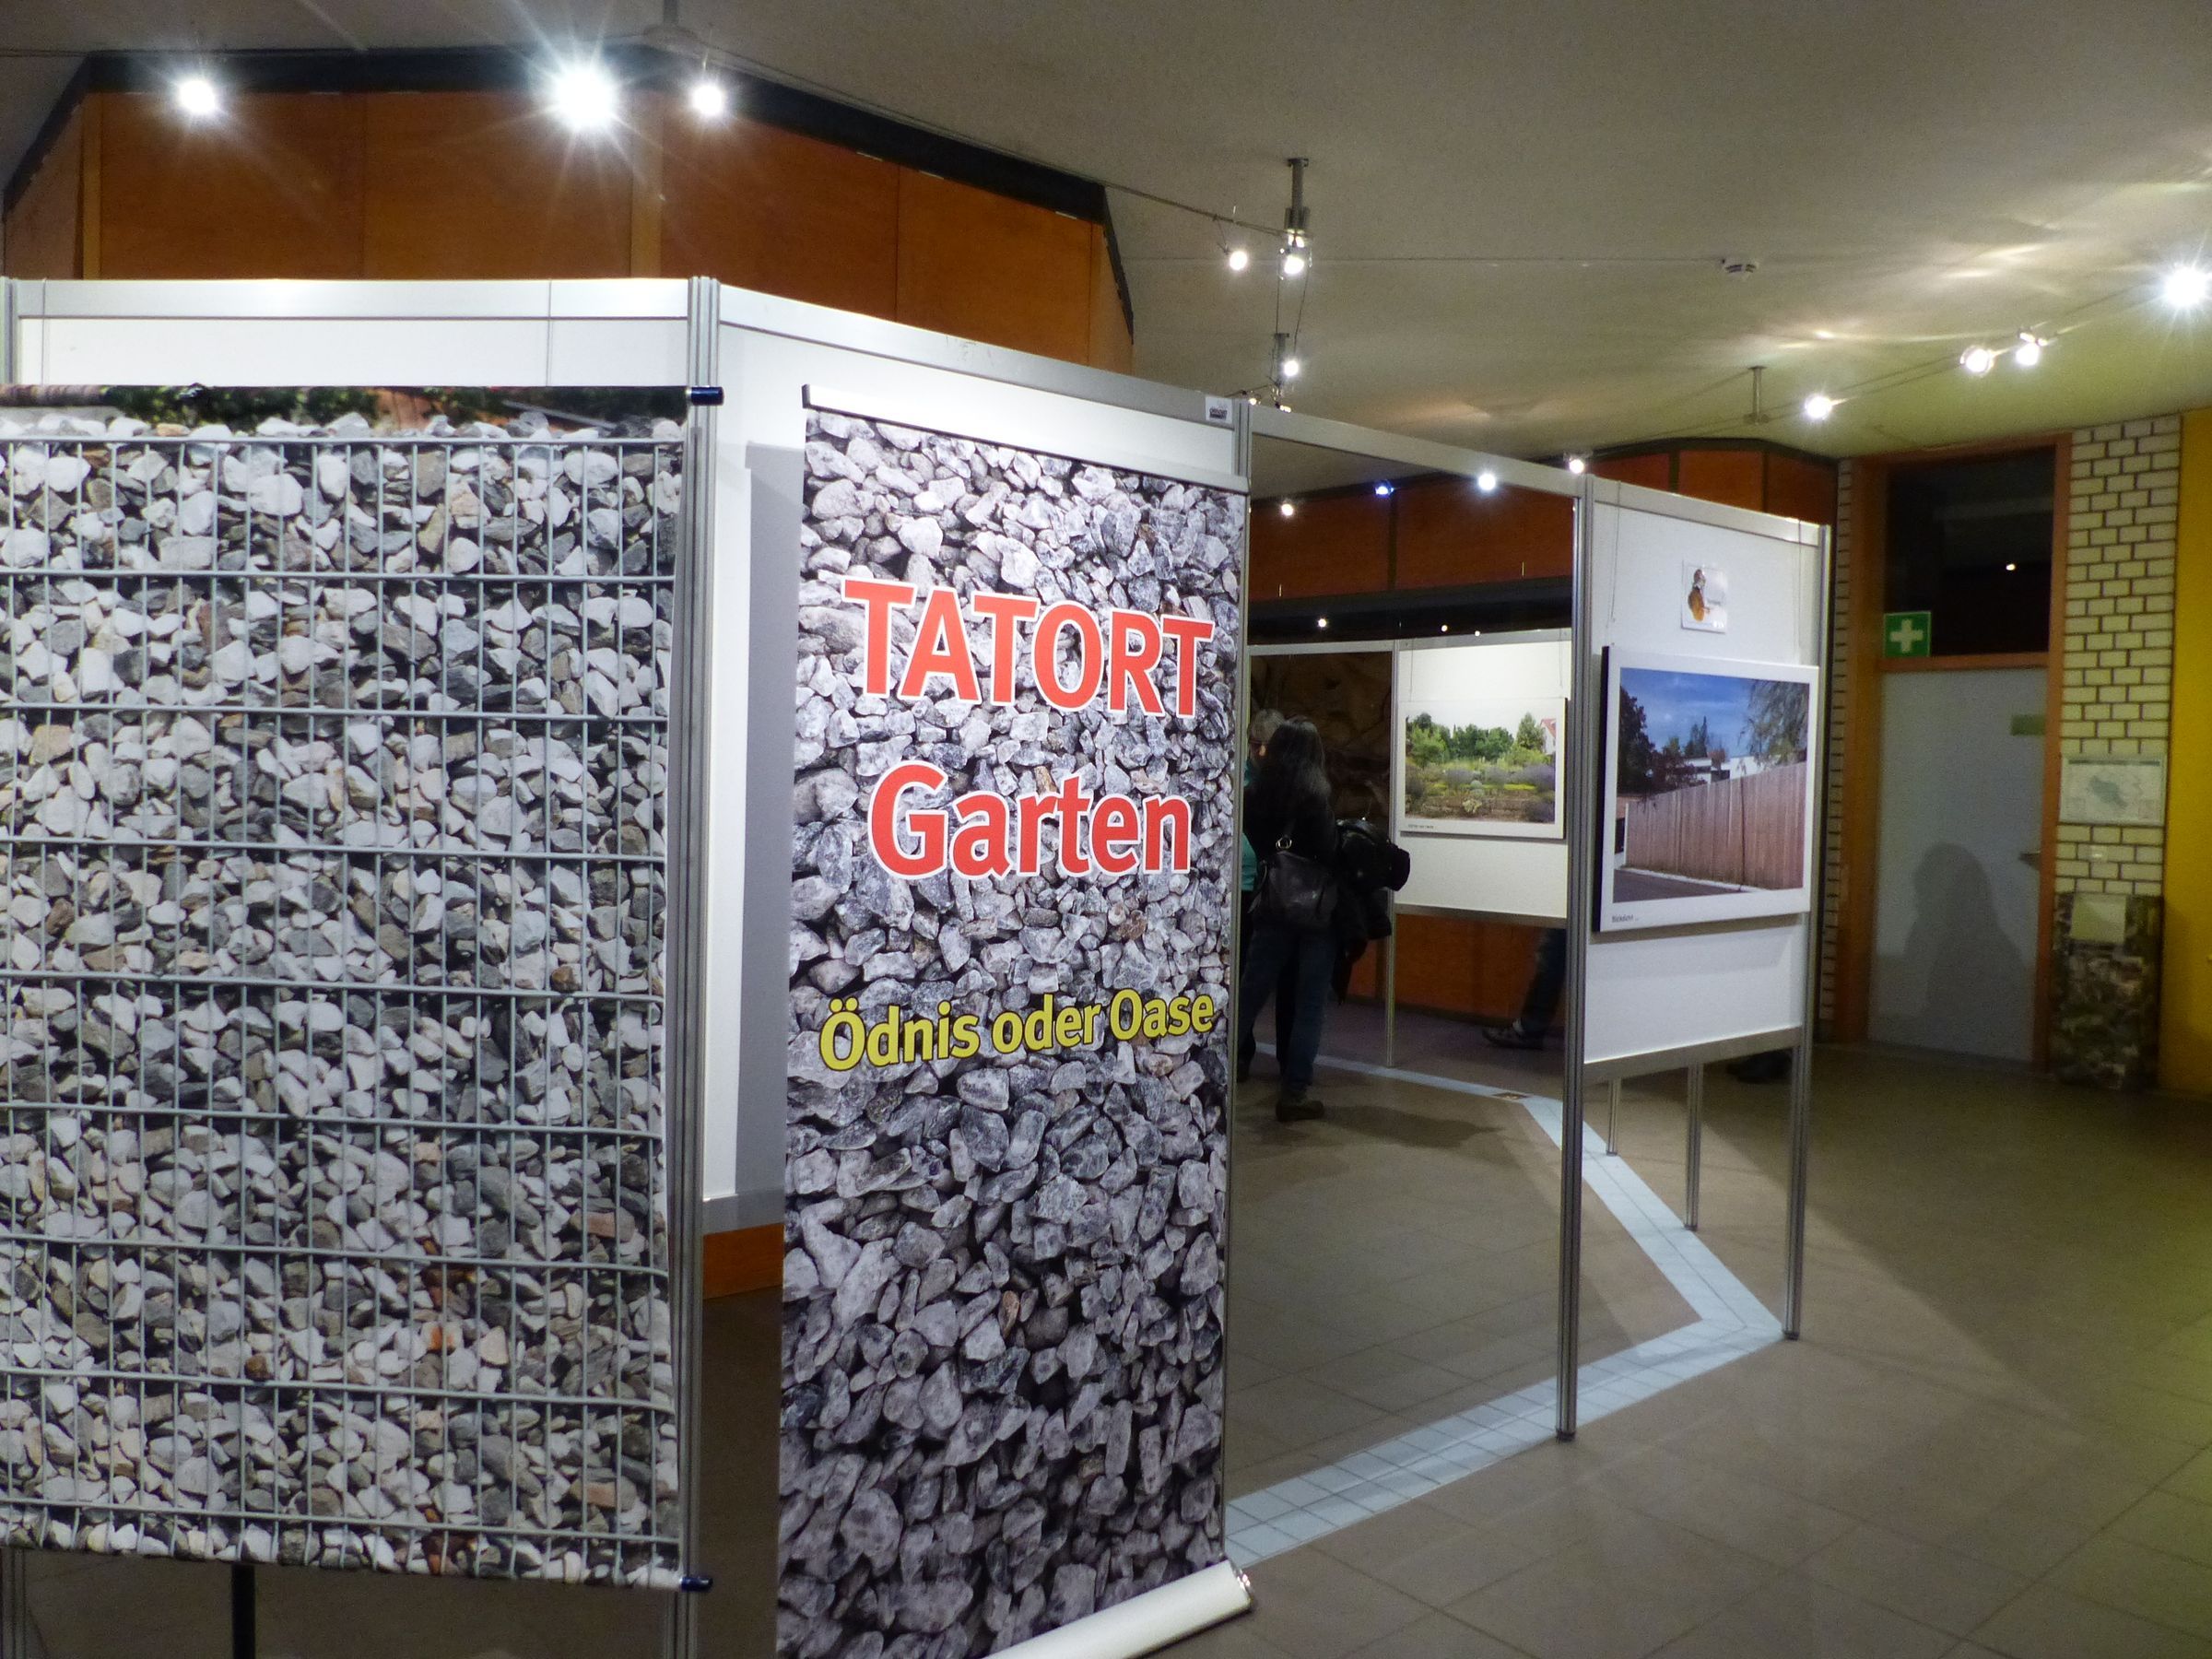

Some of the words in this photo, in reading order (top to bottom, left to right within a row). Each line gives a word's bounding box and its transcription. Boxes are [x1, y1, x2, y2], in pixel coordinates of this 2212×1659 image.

[842, 579, 1215, 718] TATORT
[870, 759, 1190, 880] Garten
[819, 997, 980, 1071] Ödnis
[991, 994, 1102, 1053] oder
[1109, 988, 1215, 1041] Oase
